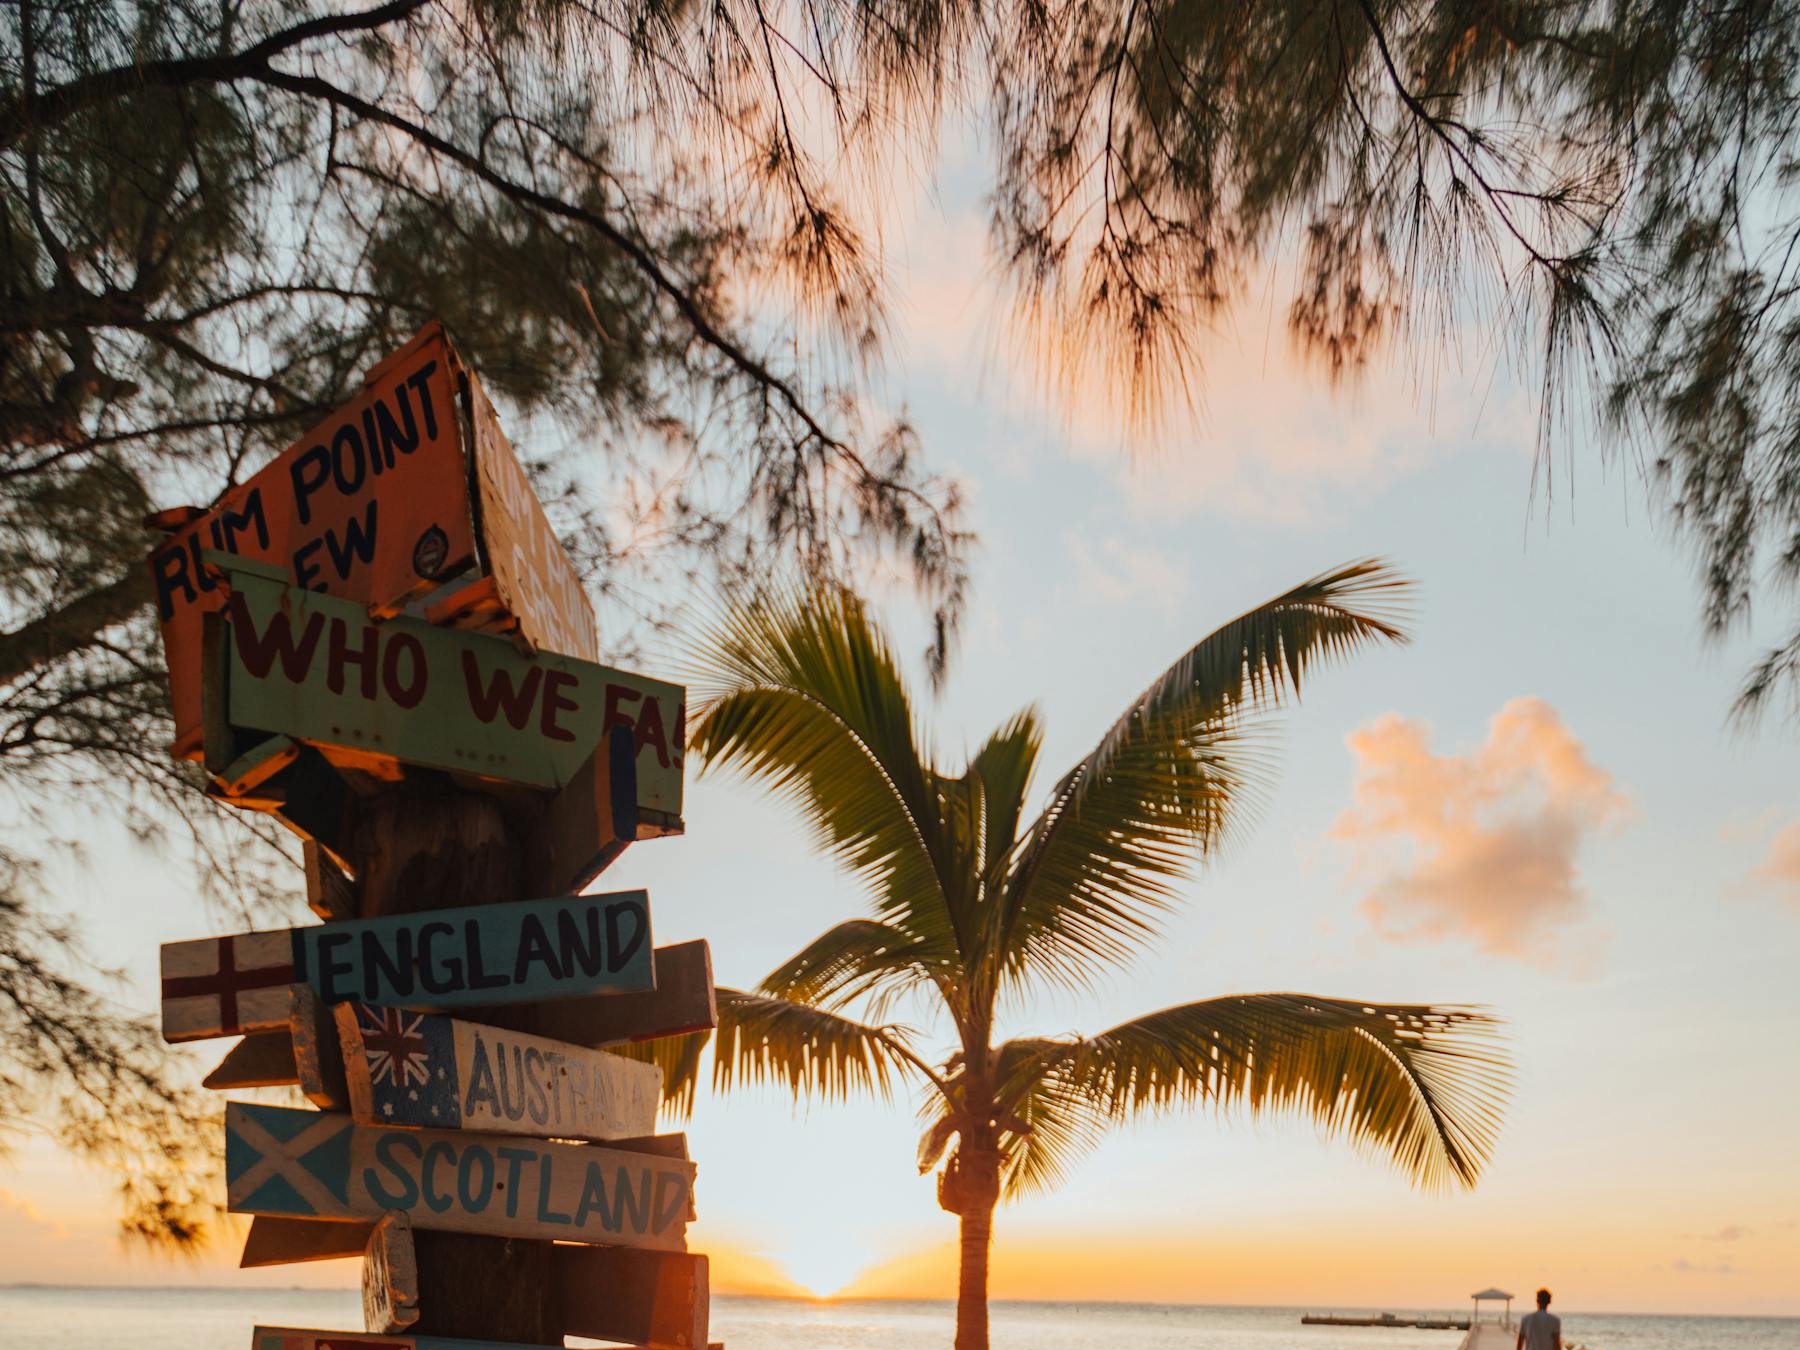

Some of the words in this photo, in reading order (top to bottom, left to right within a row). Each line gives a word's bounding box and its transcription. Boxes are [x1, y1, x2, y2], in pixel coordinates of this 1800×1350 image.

[153, 487, 270, 623] RUM
[290, 361, 438, 525] POINT
[229, 590, 428, 710] WHO
[461, 649, 579, 743] WE
[317, 900, 646, 1003] ENGLAND
[465, 1037, 646, 1132] AUSTRALIA
[364, 1132, 688, 1237] SCOTLAND
